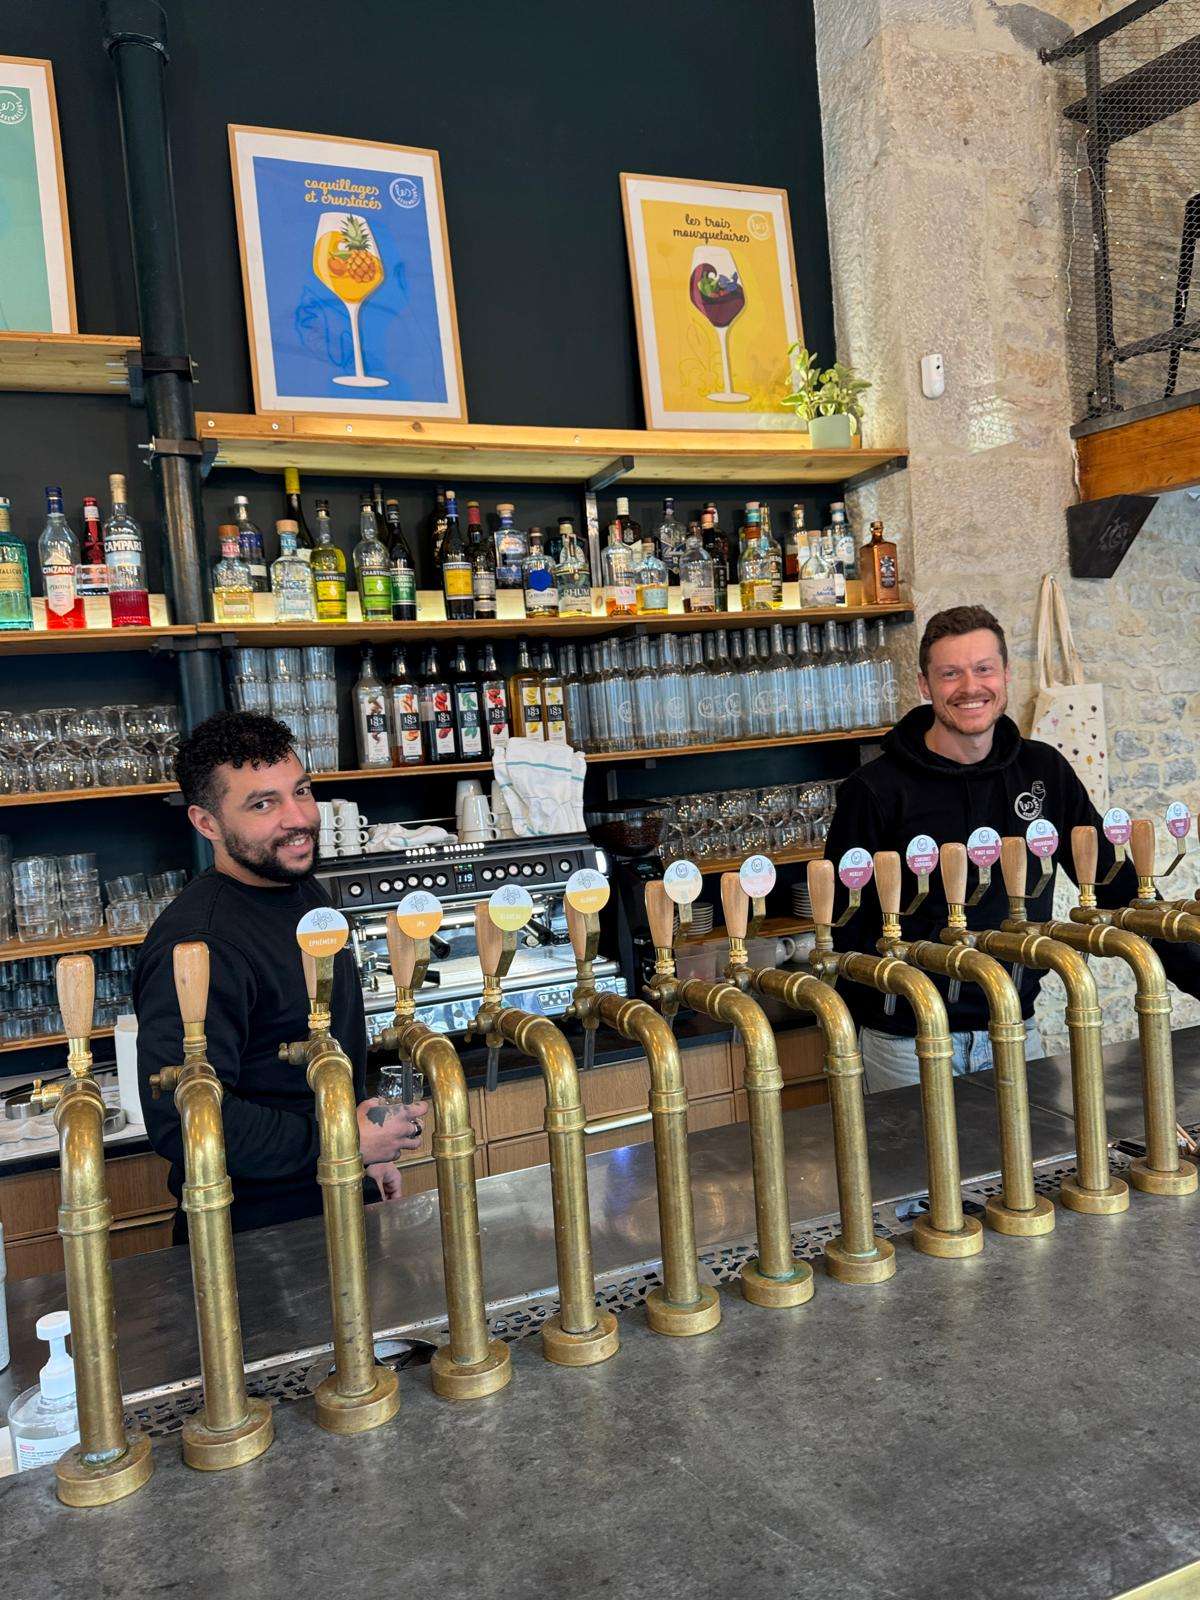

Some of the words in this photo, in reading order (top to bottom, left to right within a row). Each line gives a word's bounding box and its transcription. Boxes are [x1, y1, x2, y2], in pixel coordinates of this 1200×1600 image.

[304, 179, 379, 199] coquillages
[304, 191, 319, 203] et
[321, 194, 382, 210] crustacés
[685, 213, 701, 226] les
[704, 216, 731, 229] trois
[672, 229, 750, 245] mousquetaires
[104, 540, 142, 552] CAMPARI
[43, 565, 75, 574] CINZANO
[443, 842, 485, 853] RICHARD
